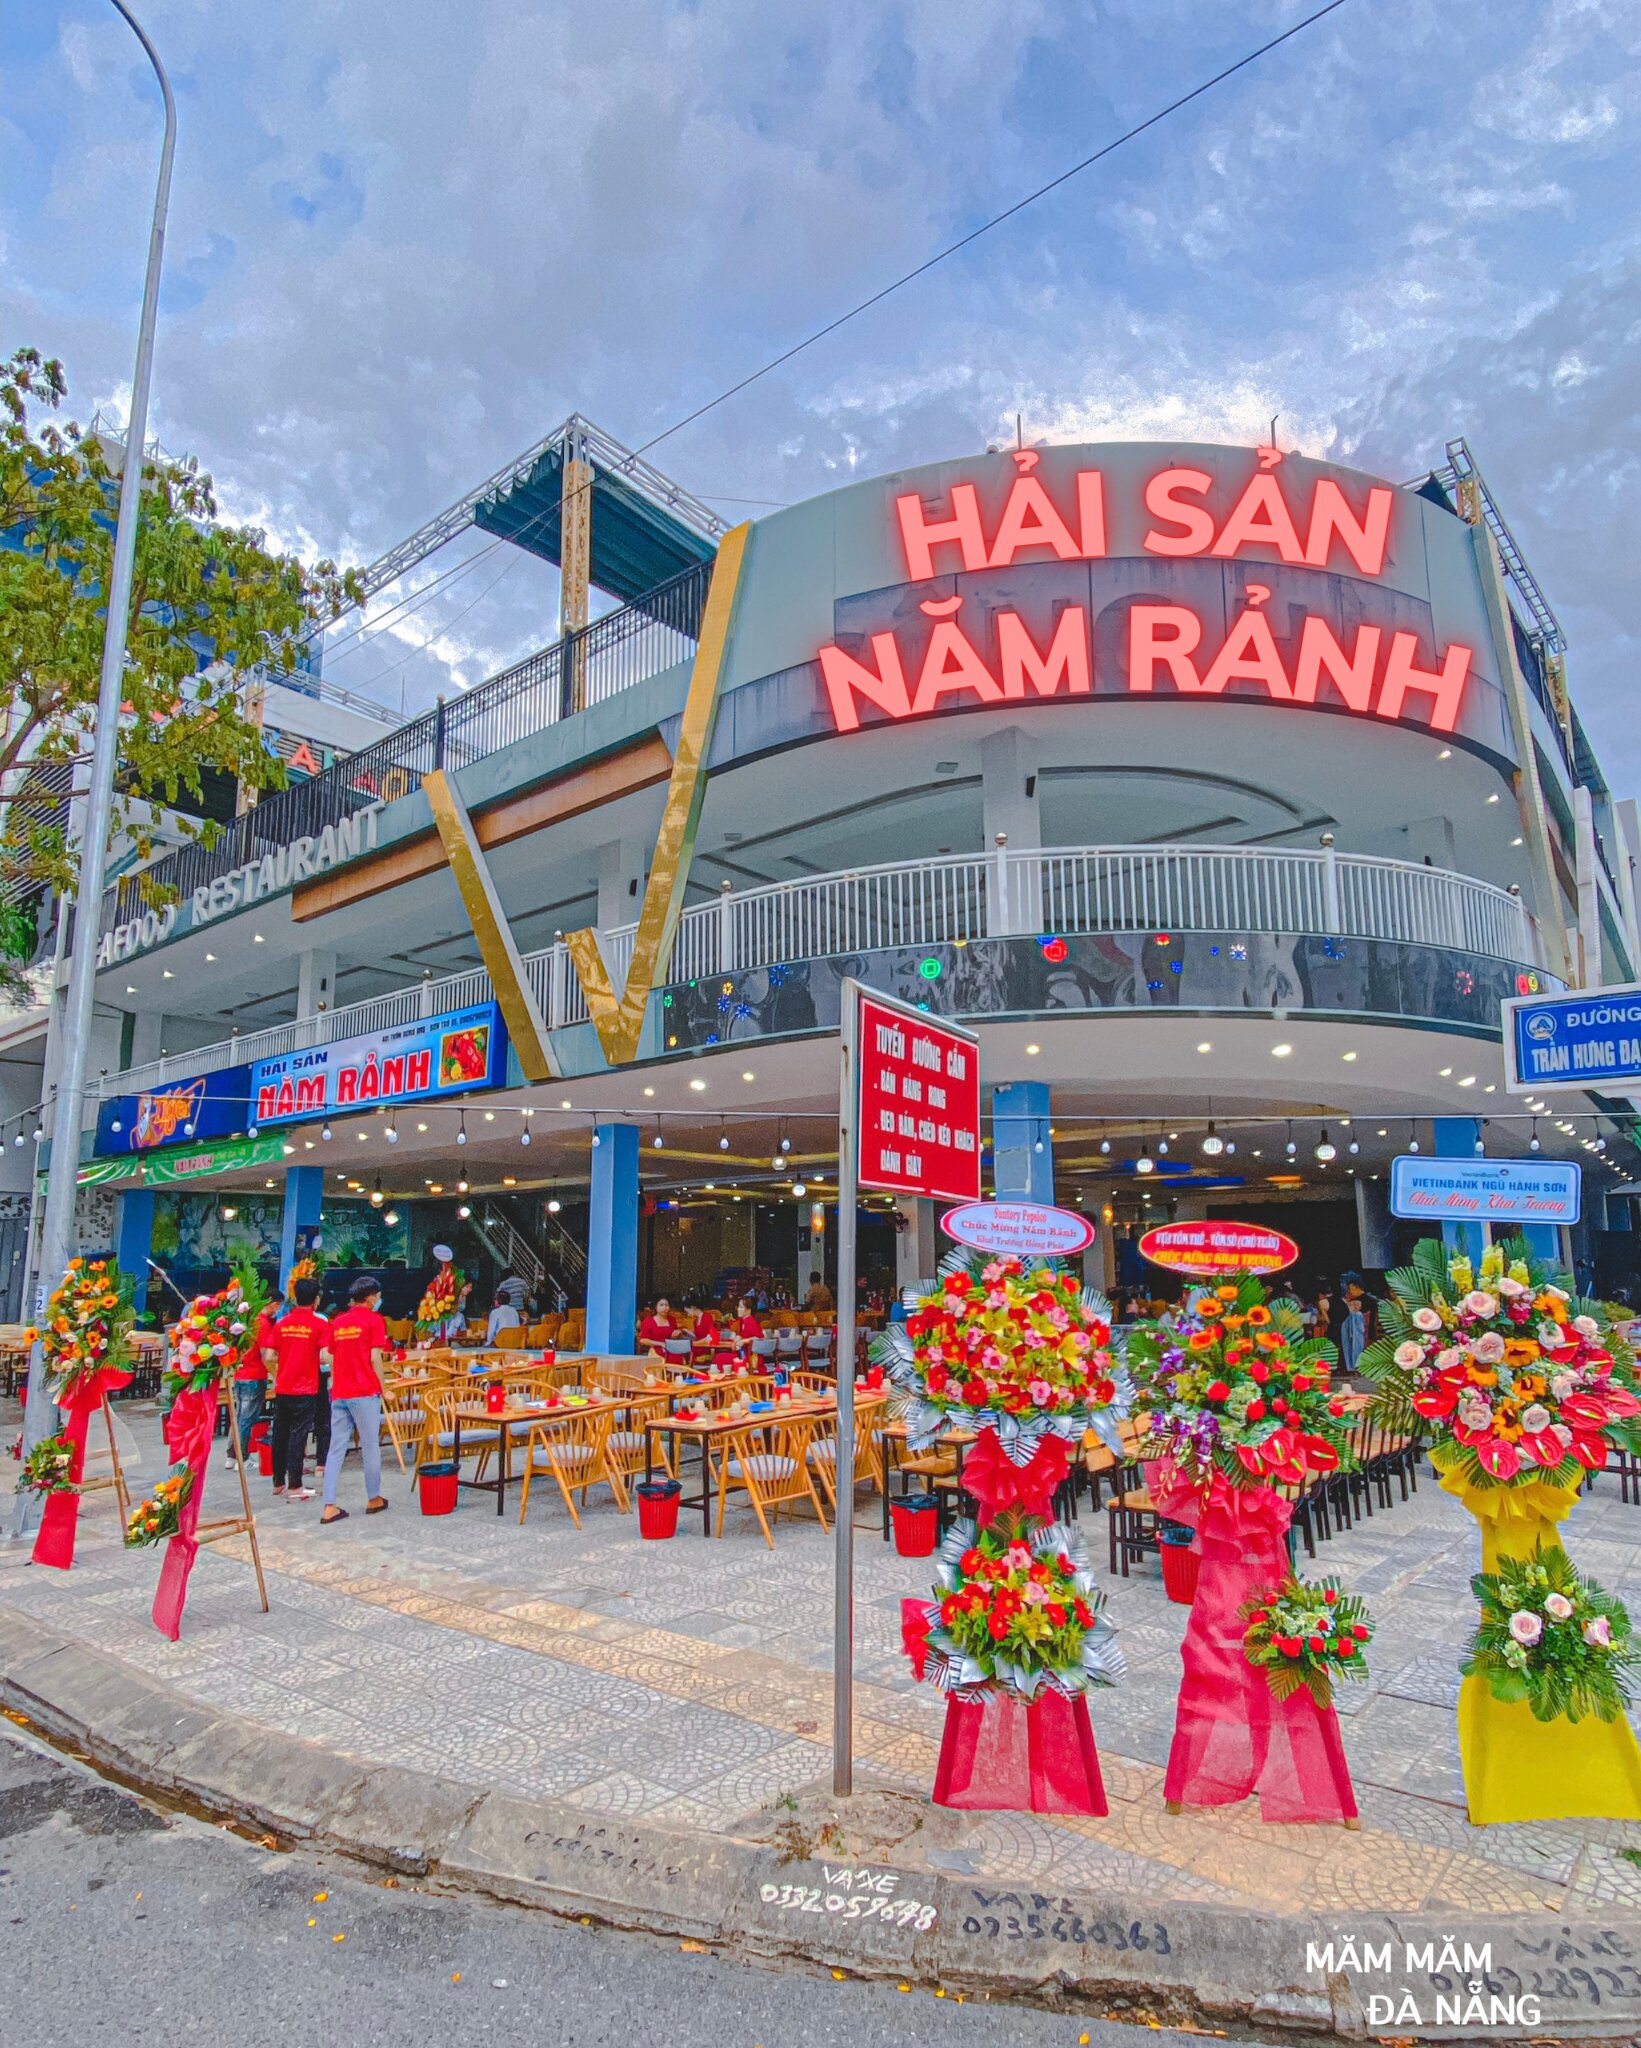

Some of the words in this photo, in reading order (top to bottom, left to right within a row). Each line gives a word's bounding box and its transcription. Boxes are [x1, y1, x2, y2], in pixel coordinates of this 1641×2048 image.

[896, 450, 1106, 581] HẢI
[1143, 447, 1393, 576] SẢN
[818, 595, 1091, 732] NĂM
[1129, 583, 1472, 732] RẢNH
[191, 800, 386, 926] RESTAURANT
[1567, 1005, 1641, 1028] ĐƯỜNG
[261, 1060, 287, 1078] HẢI
[292, 1051, 328, 1071] SẢN
[876, 1022, 905, 1060] TUYẾN
[912, 1035, 941, 1073] ĐƯỜNG
[1532, 1037, 1570, 1074] TRẦN
[1573, 1040, 1616, 1070] HƯNG
[1618, 1038, 1641, 1069] ĐẠ
[257, 1073, 327, 1120] NĂM
[336, 1050, 432, 1106] RẢNH
[880, 1066, 896, 1095] BÁN
[902, 1072, 922, 1103] HÀNG
[928, 1084, 946, 1110] RONG
[880, 1143, 901, 1174] ĐÁNH
[1412, 1177, 1478, 1190] VIETINBANK
[1543, 1182, 1567, 1193] SƠN
[961, 1219, 988, 1231] Chúc
